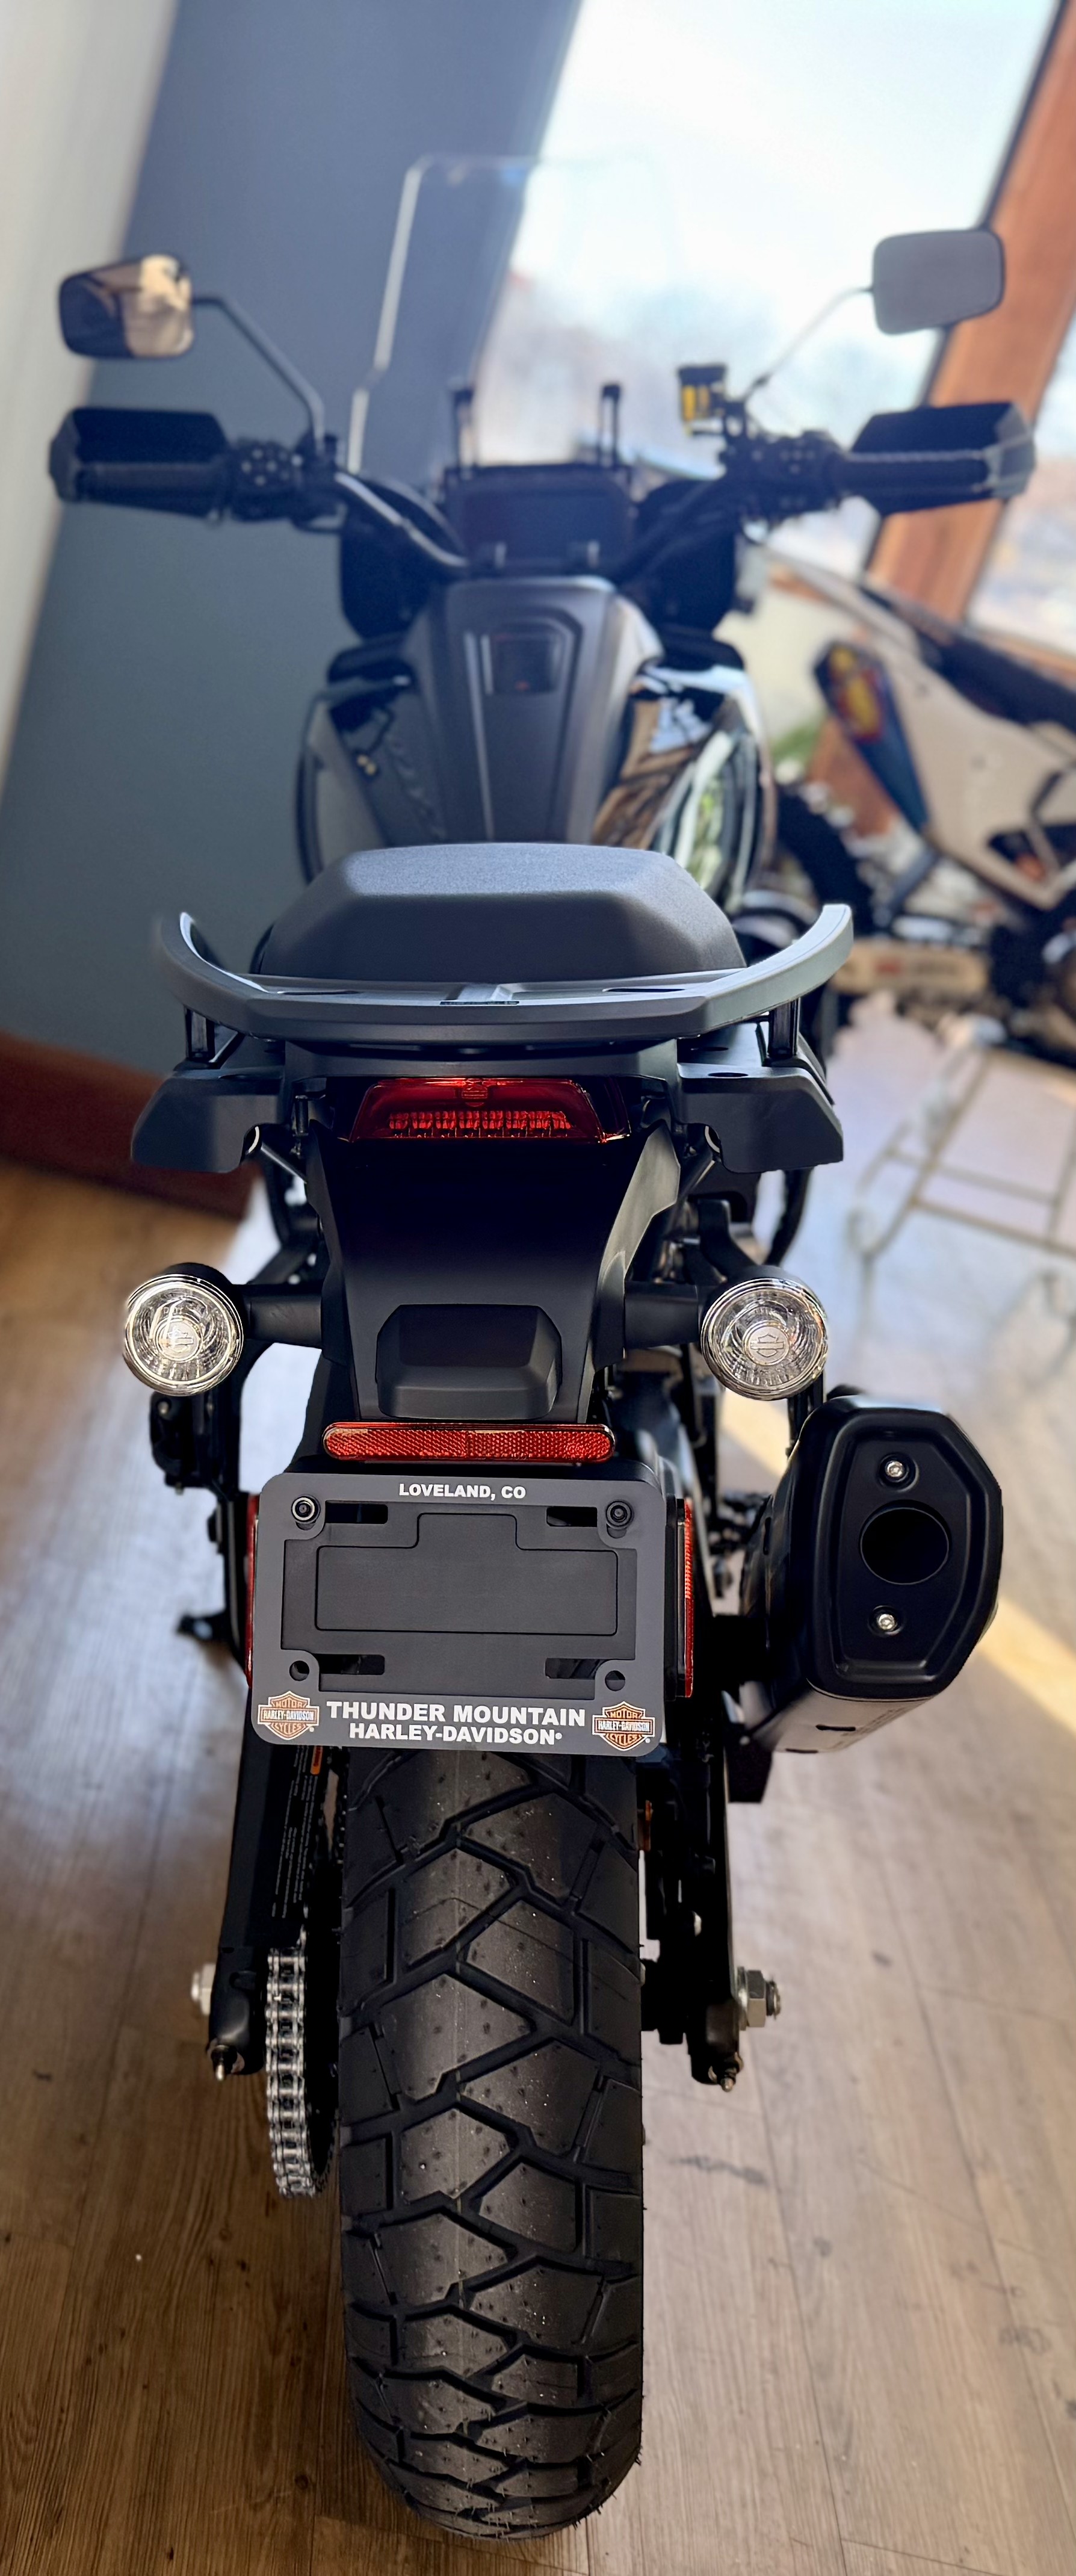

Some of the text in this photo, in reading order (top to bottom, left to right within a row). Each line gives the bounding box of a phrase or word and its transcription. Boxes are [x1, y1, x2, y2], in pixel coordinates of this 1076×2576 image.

[399, 1483, 526, 1500] LOVELAND, CO
[276, 1698, 303, 1708] MOTOR
[326, 1701, 586, 1727] THUNDER MOUNTAIN
[610, 1709, 639, 1719] MOTOR
[274, 1722, 302, 1735] CYCLES
[610, 1733, 638, 1745] CYCLES
